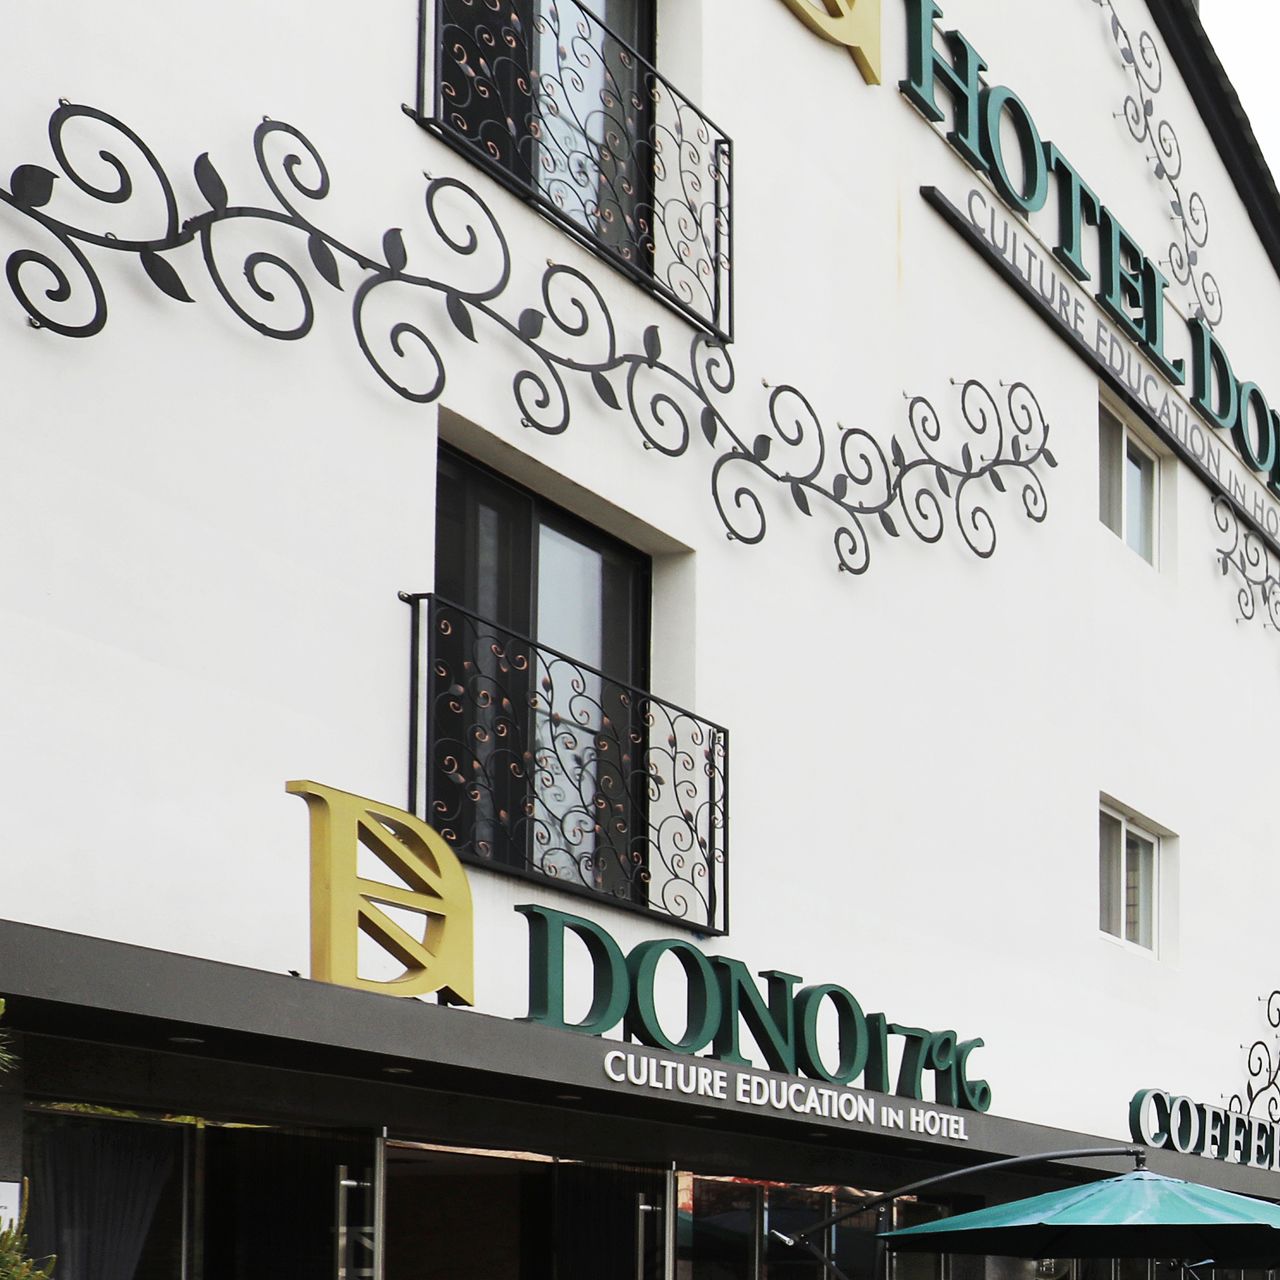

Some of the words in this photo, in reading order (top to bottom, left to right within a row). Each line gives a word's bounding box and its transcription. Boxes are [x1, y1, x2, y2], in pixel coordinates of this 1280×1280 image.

[899, 0, 1186, 386] HOTEL
[967, 188, 1085, 340] CULTURE
[1095, 318, 1221, 482] EDUCATION
[1227, 468, 1246, 507] IN
[604, 1050, 727, 1099] CULTURE
[736, 1072, 874, 1125] EDUCATION
[881, 1106, 903, 1130] IN
[910, 1107, 968, 1140] HOTEL
